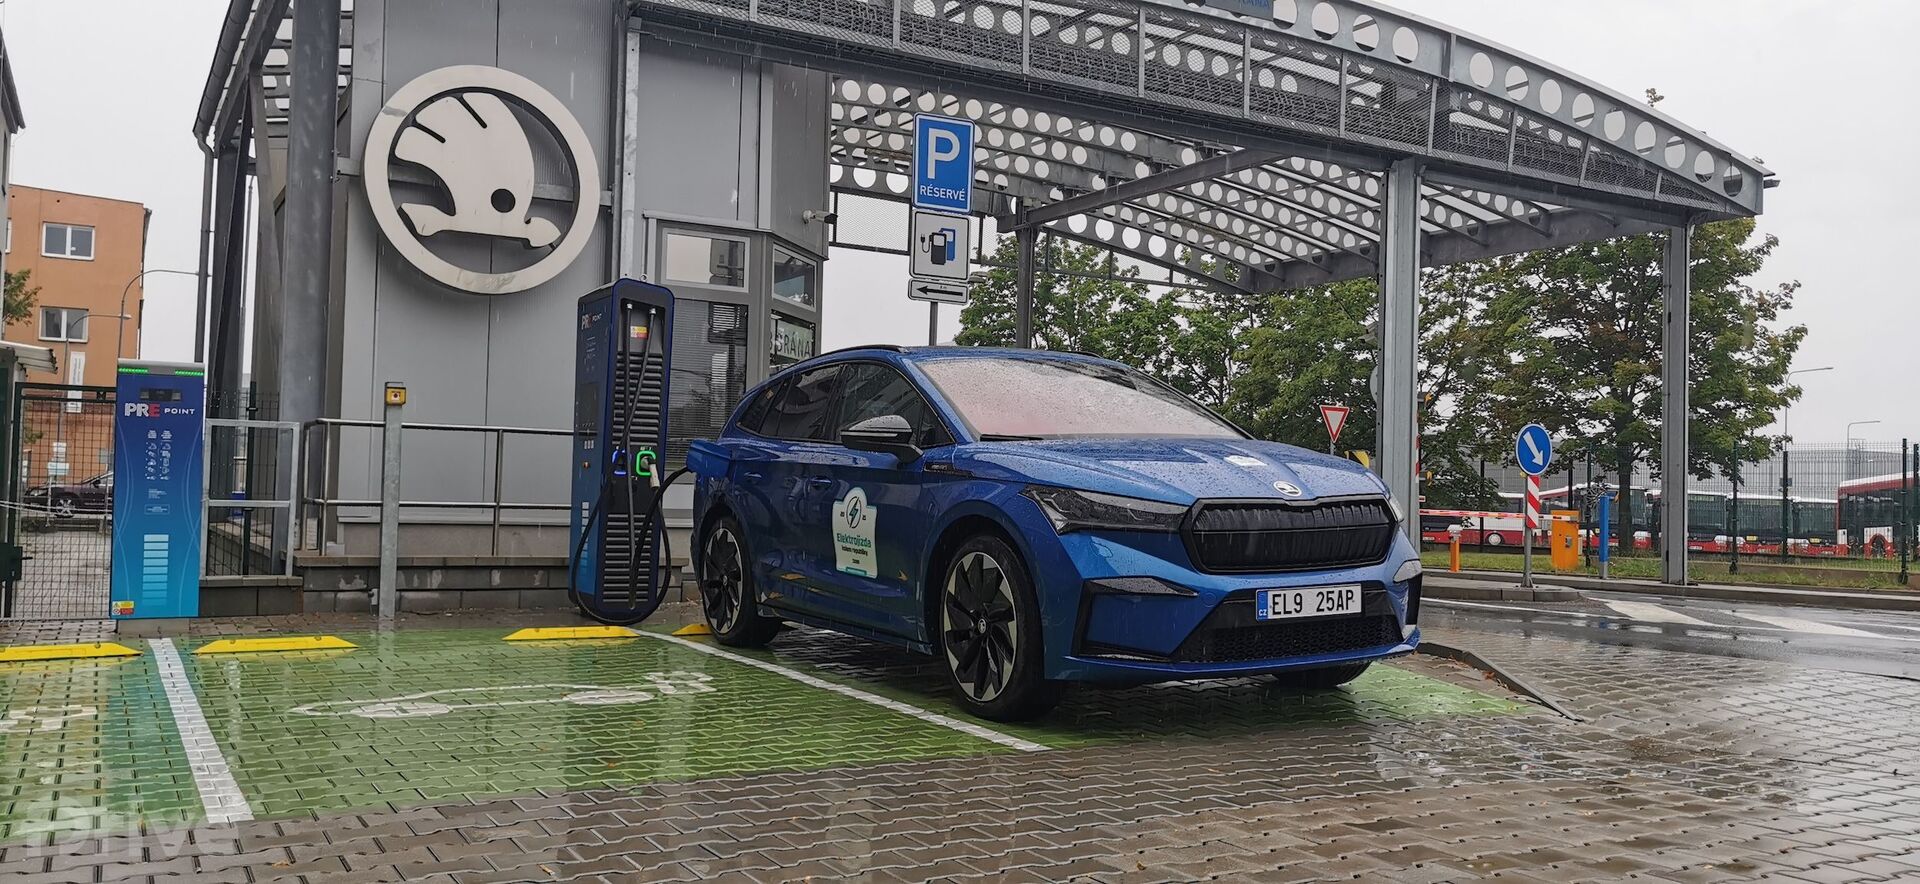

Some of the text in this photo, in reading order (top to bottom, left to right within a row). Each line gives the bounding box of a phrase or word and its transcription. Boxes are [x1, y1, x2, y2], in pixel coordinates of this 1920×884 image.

[927, 127, 961, 180] P
[920, 183, 966, 201] RÉSERVÉ
[124, 402, 196, 417] PRE POINT
[1272, 593, 1303, 615] EL9
[1316, 590, 1354, 612] 25AP
